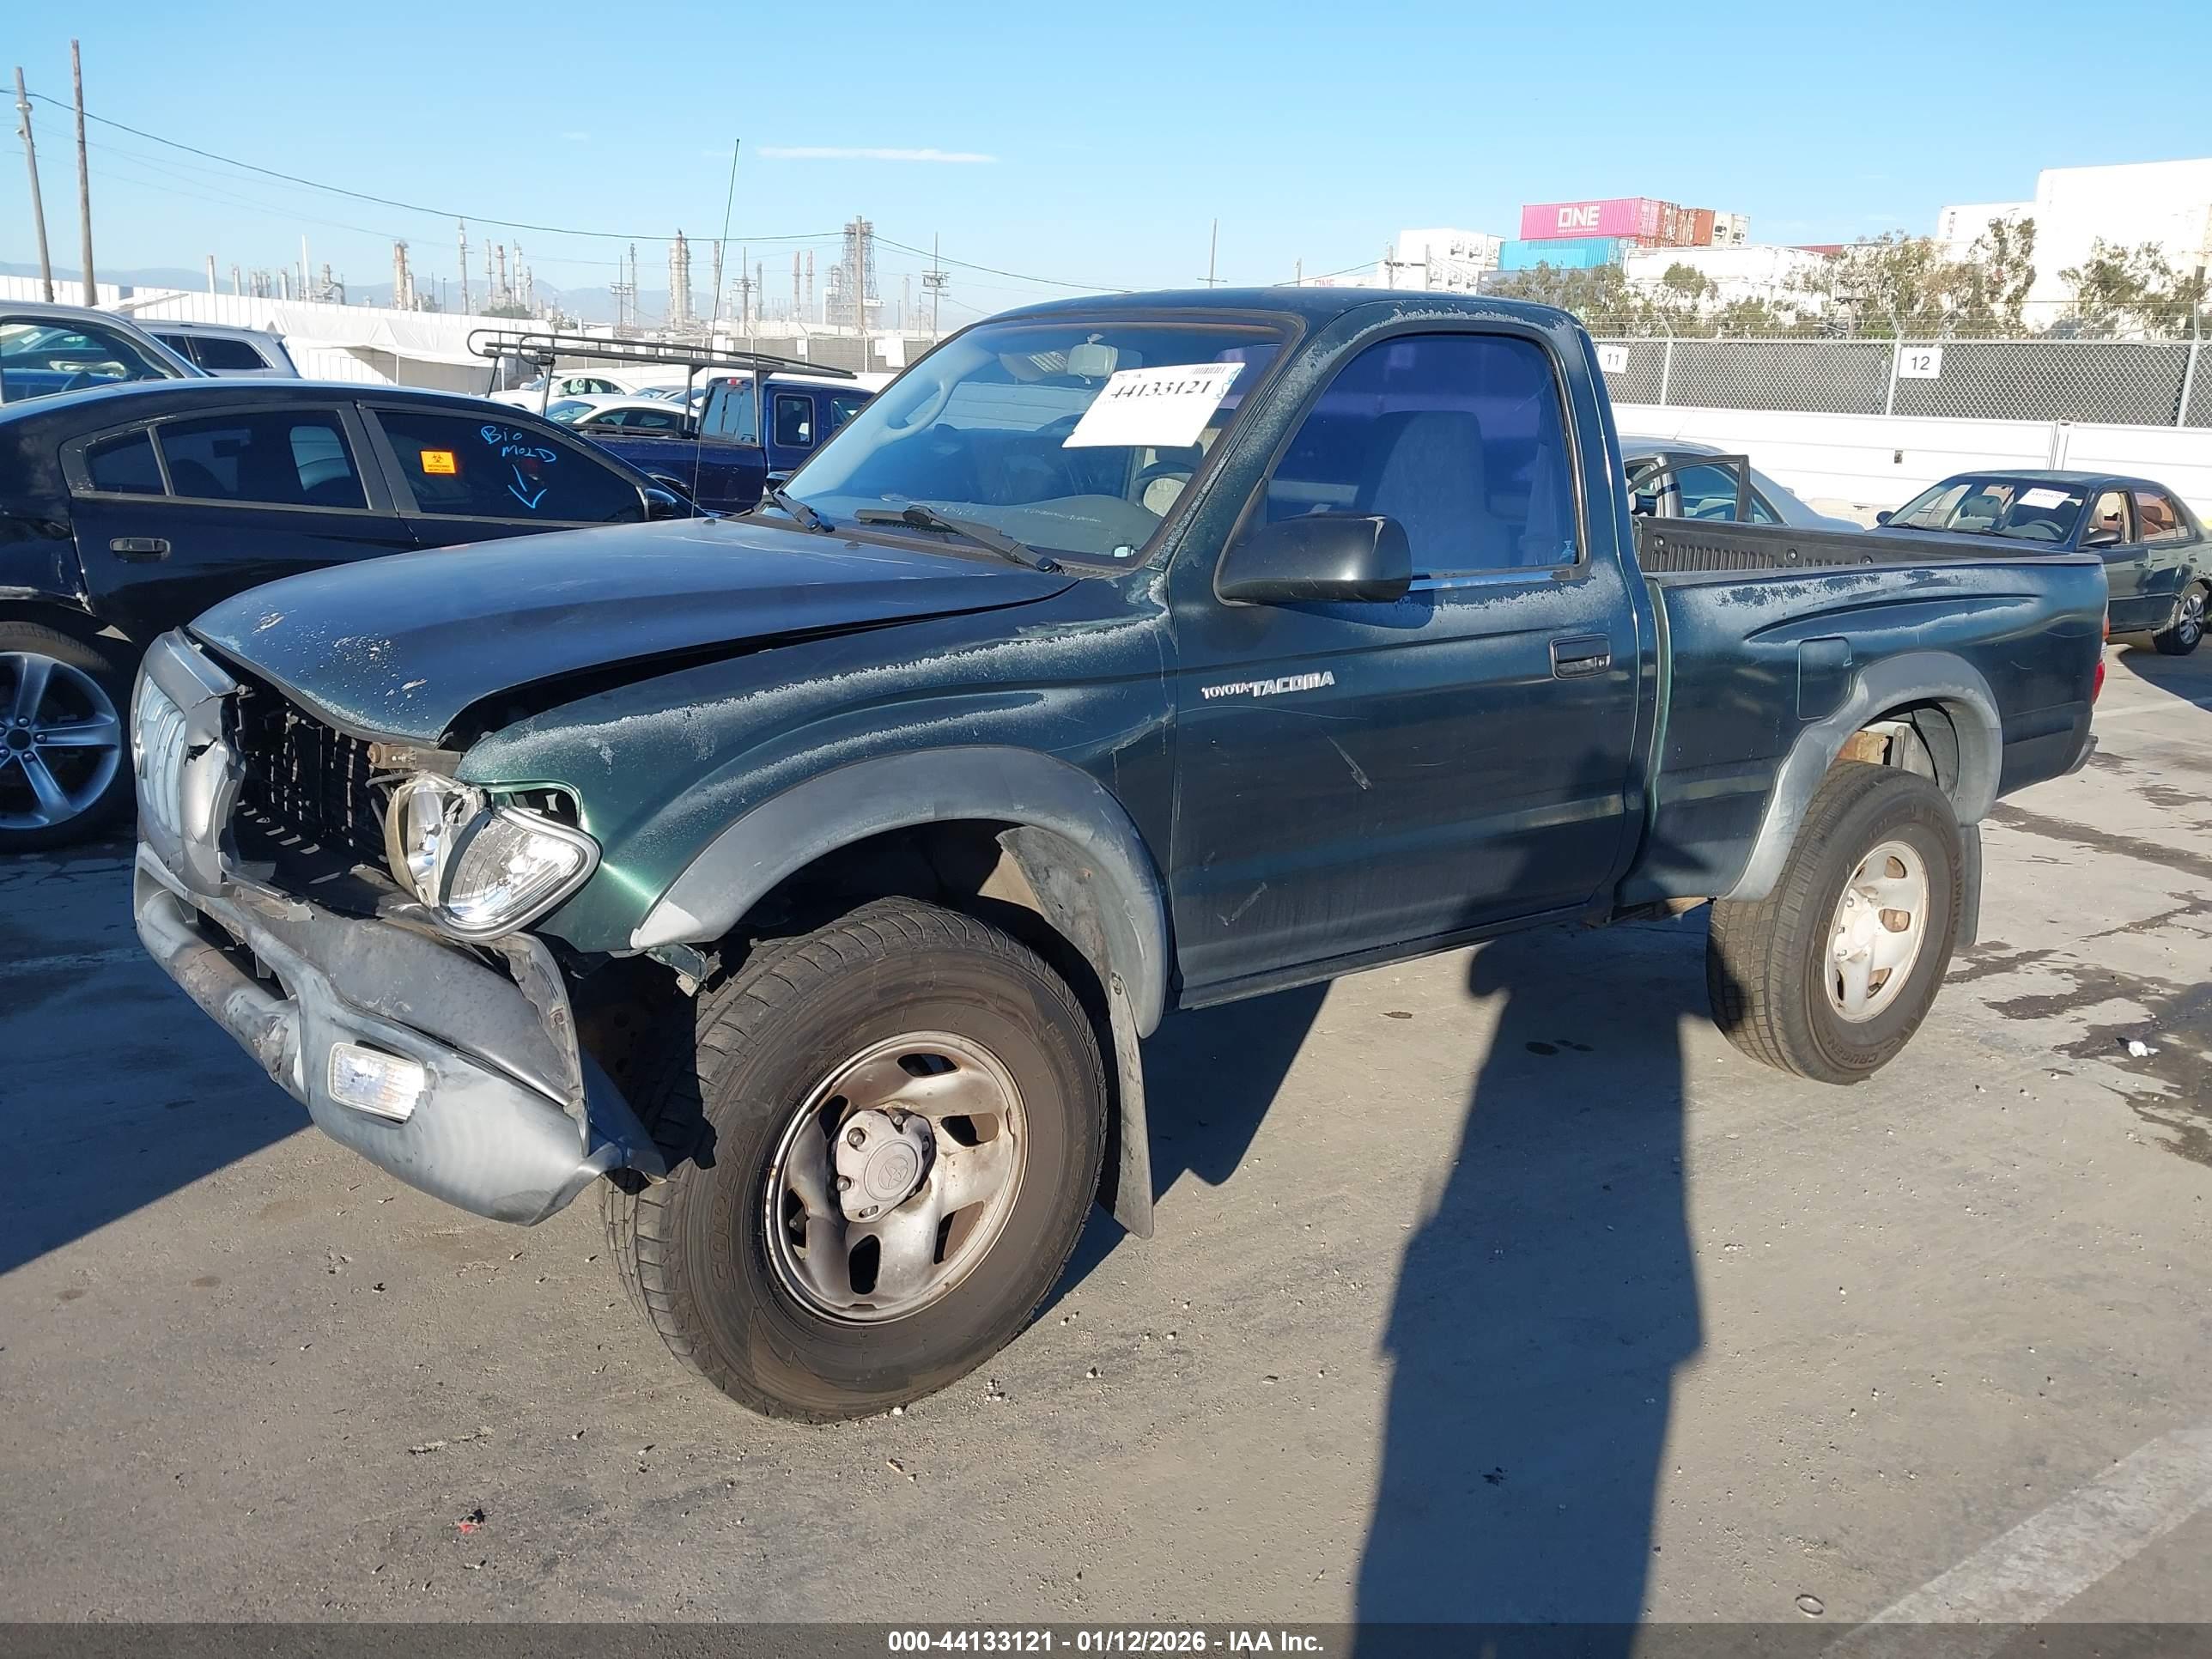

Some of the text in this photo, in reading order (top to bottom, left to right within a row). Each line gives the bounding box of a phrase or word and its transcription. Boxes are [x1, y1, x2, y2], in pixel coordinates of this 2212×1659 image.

[1558, 205, 1600, 228] ONE
[1607, 353, 1620, 365] 11
[1911, 356, 1930, 370] 12
[1110, 380, 1212, 399] 44133121
[1201, 671, 1335, 700] TOYOTA TACOMA
[708, 1125, 756, 1291] CORSA
